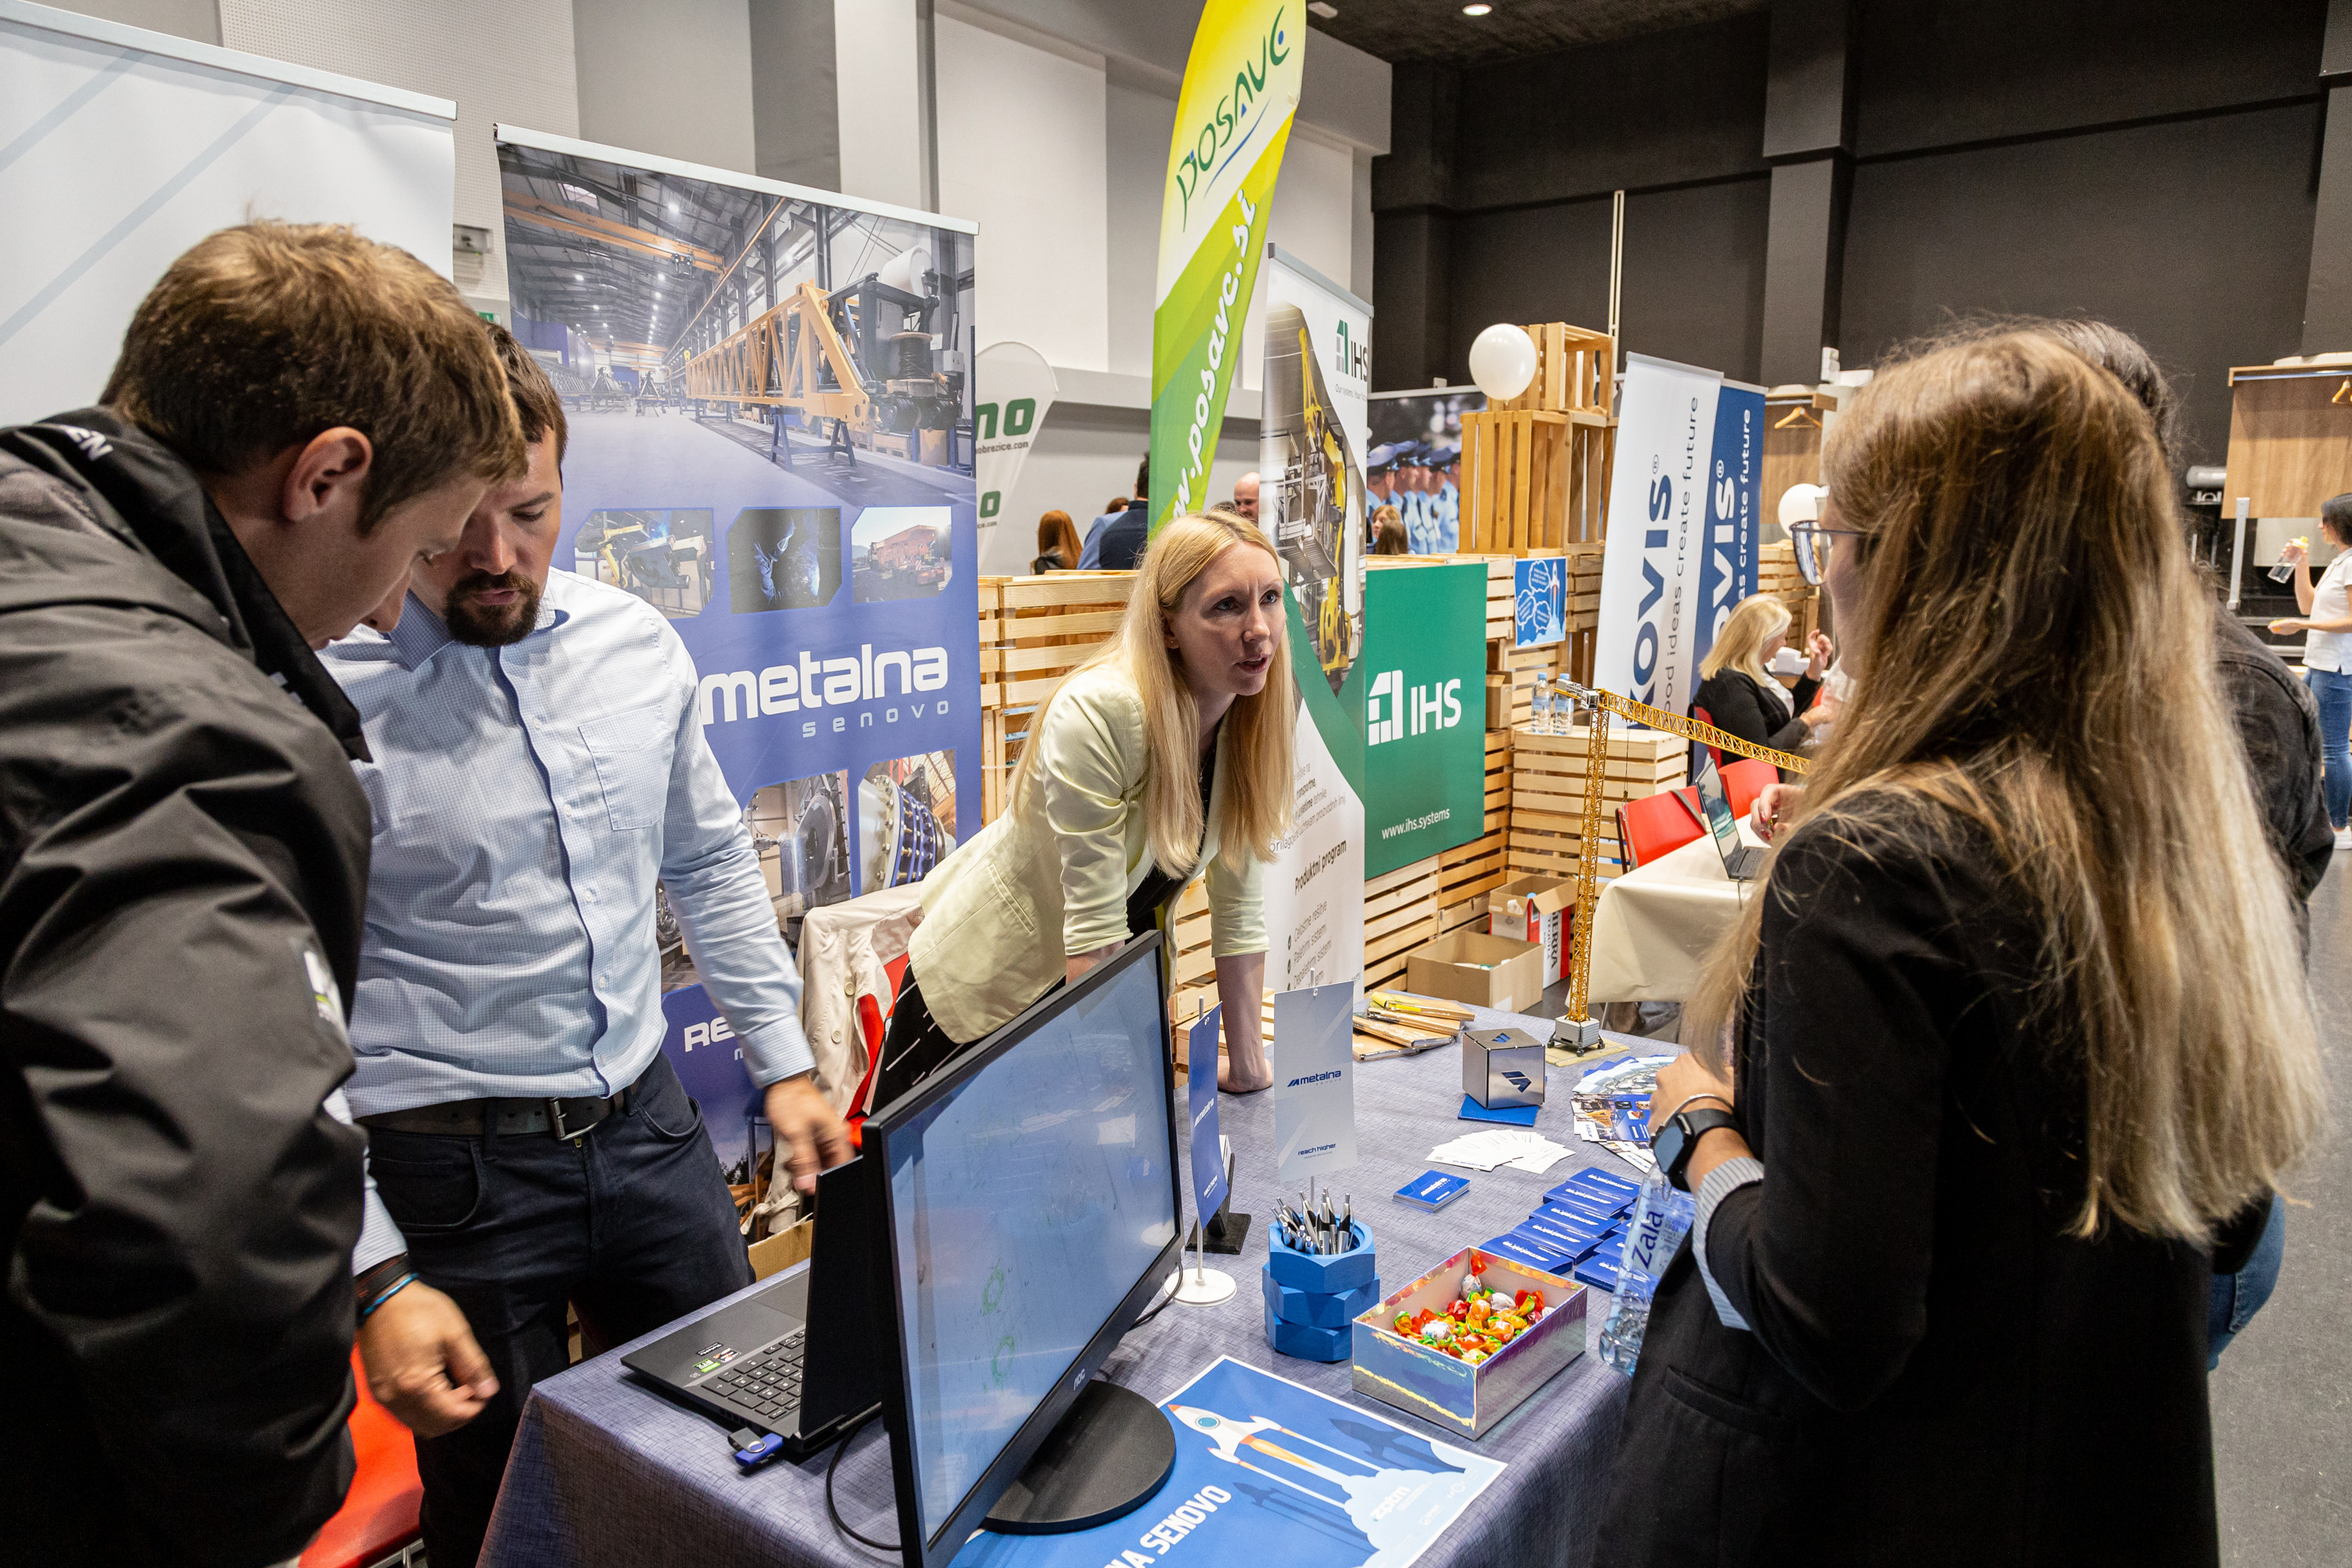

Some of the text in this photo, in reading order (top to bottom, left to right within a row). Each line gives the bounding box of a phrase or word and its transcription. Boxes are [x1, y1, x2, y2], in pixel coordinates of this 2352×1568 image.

[1682, 397, 1698, 481] future
[1740, 409, 1751, 484] future
[1676, 491, 1690, 577] create
[1739, 492, 1748, 568] create
[1667, 586, 1682, 657] ideas
[699, 644, 949, 725] metalna
[1411, 678, 1462, 736] IHS
[801, 699, 949, 739] senovo
[1381, 808, 1450, 840] www.ihs.systems
[1295, 839, 1347, 896] Produktni program
[1551, 909, 1561, 970] IERRA
[1300, 1070, 1341, 1085] metalna
[1298, 1147, 1316, 1156] reach
[1317, 1143, 1336, 1154] higher
[1632, 1210, 1664, 1271] Zala
[1073, 1368, 1086, 1392] AOC
[1139, 1485, 1232, 1555] SENOVO
